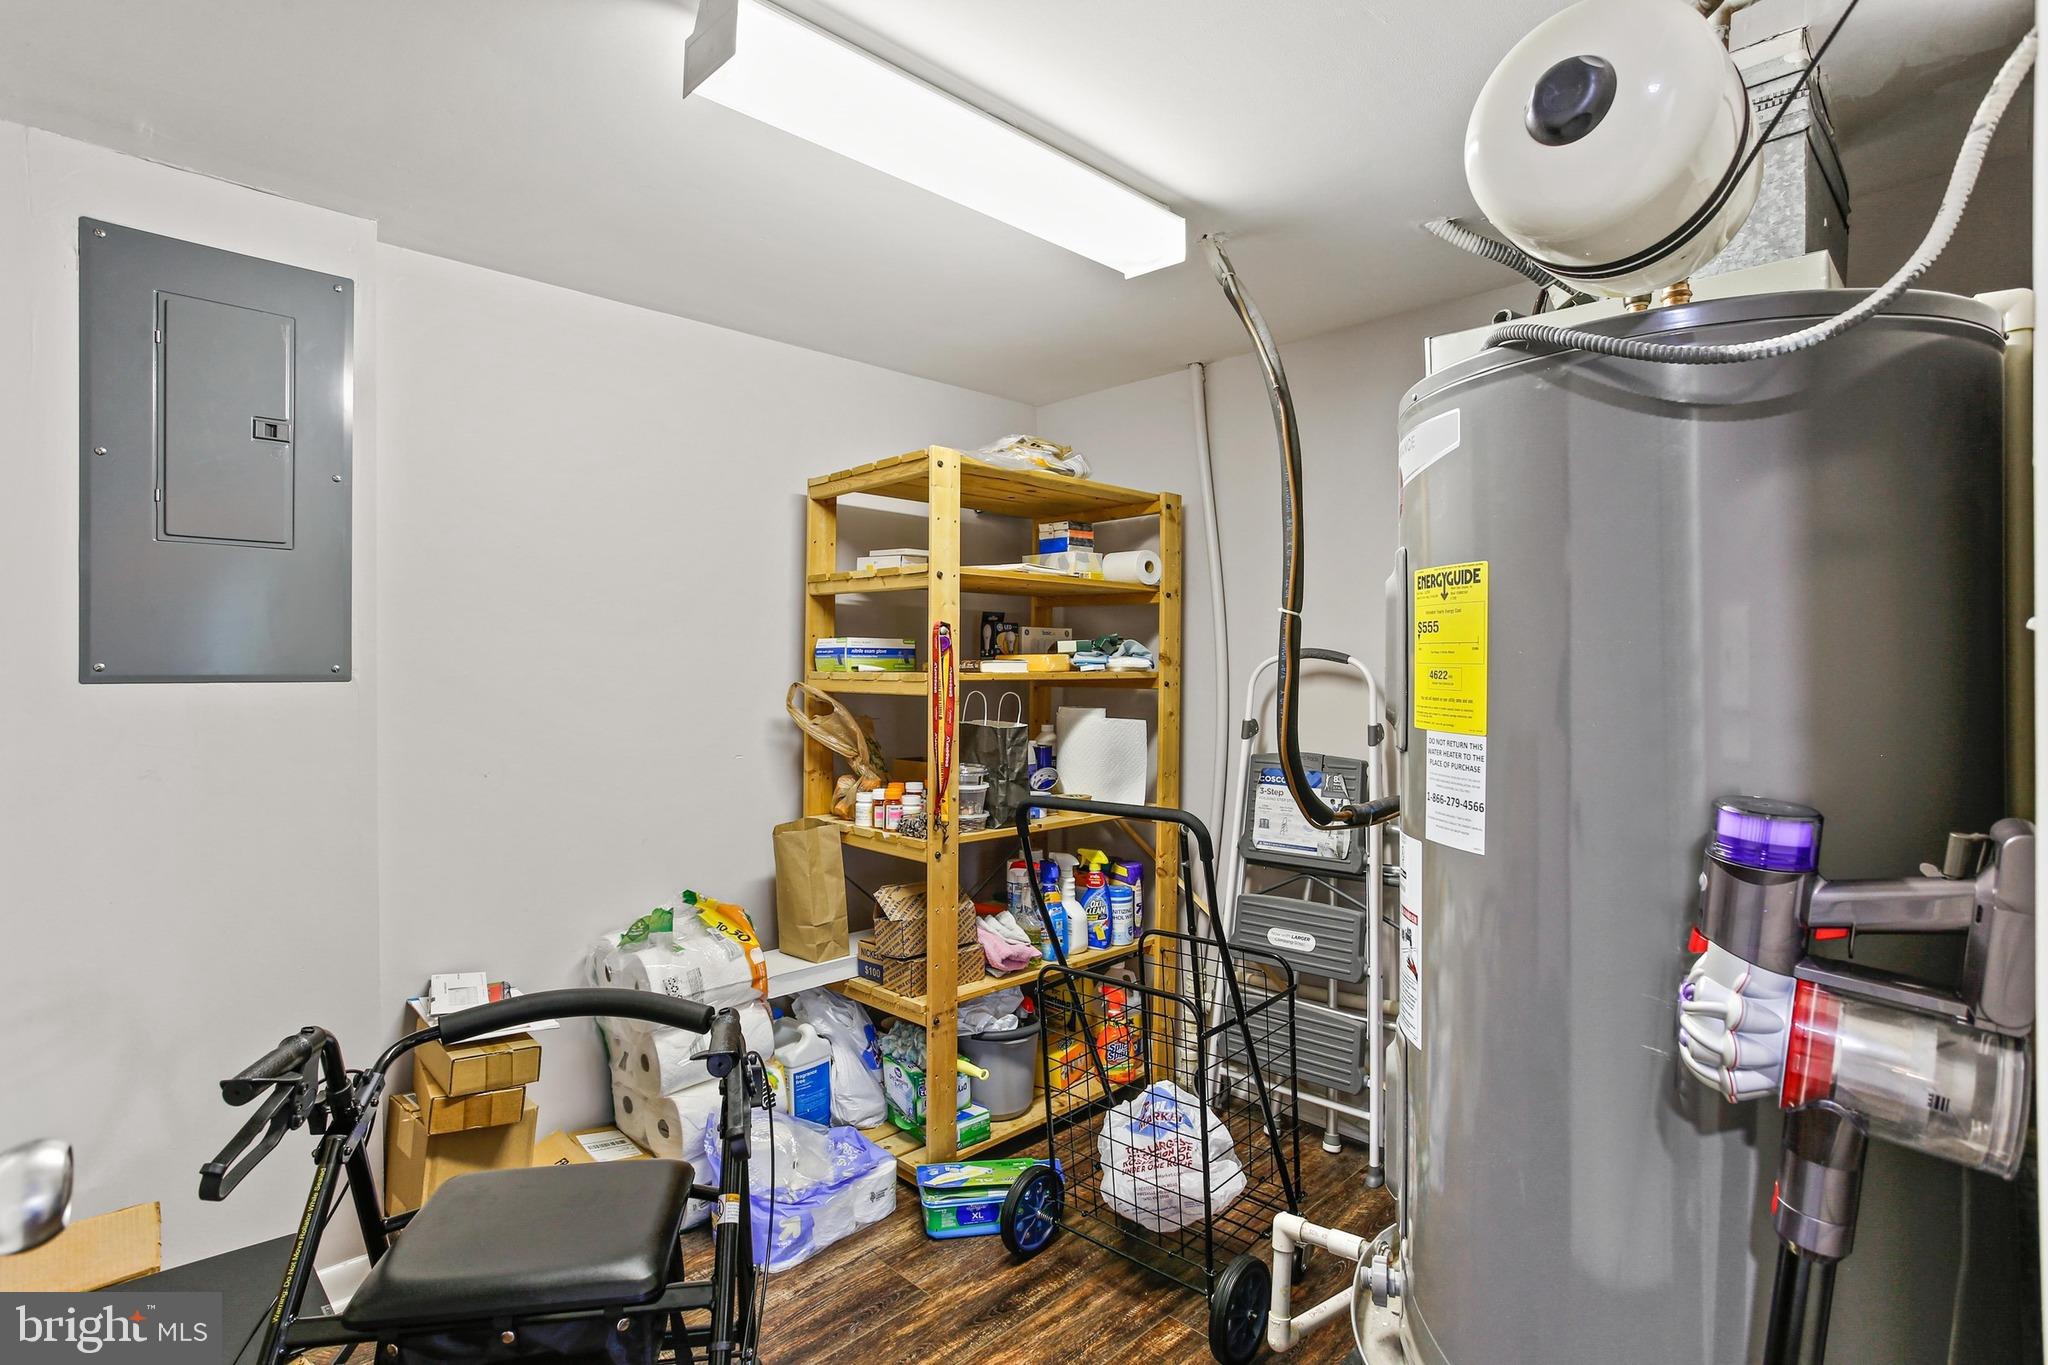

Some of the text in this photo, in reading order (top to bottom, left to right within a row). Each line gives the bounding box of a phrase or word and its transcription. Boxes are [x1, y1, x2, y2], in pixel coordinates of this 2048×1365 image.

[1417, 568, 1481, 590] ENERGYGUIDE
[1417, 620, 1440, 634] $555
[1430, 670, 1448, 680] 4622
[1446, 740, 1468, 749] RETURN
[1469, 742, 1483, 751] THIS
[1428, 748, 1485, 763] WATER HEATER TO THE
[1430, 758, 1481, 774] PLACE OF PURCHASE
[1260, 787, 1284, 797] 3-Step
[1427, 791, 1485, 813] 1-866-279-4566
[1086, 906, 1106, 914] CLEAN
[1090, 900, 1102, 908] OXI
[1291, 934, 1311, 942] LARGER
[864, 965, 881, 978] $100
[795, 1069, 818, 1080] fragrance
[1147, 1138, 1193, 1154] LARGS
[314, 1167, 327, 1191] Seated
[307, 1192, 319, 1212] While
[971, 1212, 985, 1220] XL
[299, 1213, 312, 1239] Rollator
[292, 1240, 303, 1261] Move
[287, 1261, 297, 1275] Not
[283, 1276, 292, 1287] Do
